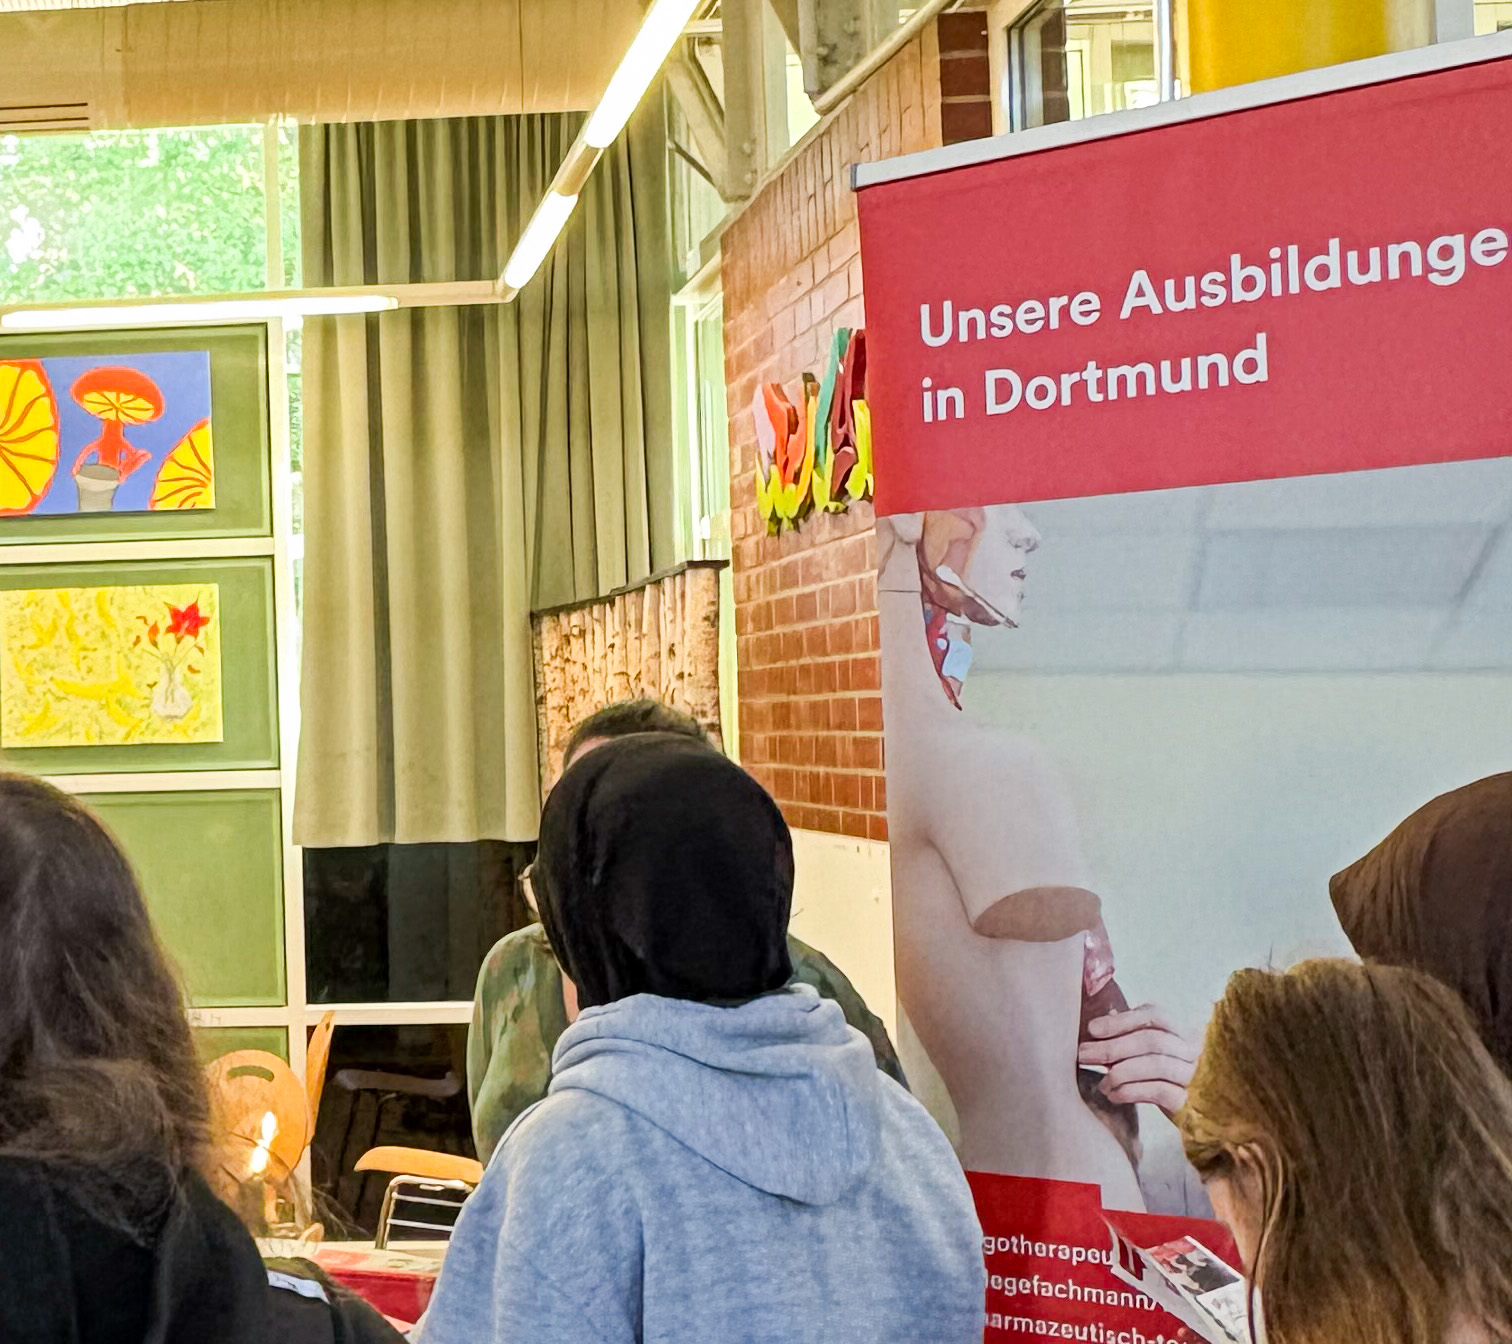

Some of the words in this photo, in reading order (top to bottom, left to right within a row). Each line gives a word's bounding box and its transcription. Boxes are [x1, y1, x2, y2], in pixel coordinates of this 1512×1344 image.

[919, 289, 1101, 348] Unsere
[1120, 226, 1509, 320] Ausbildunge
[922, 376, 965, 423] in
[984, 332, 1269, 416] Dortmund
[983, 1234, 1114, 1267] gotherapeu
